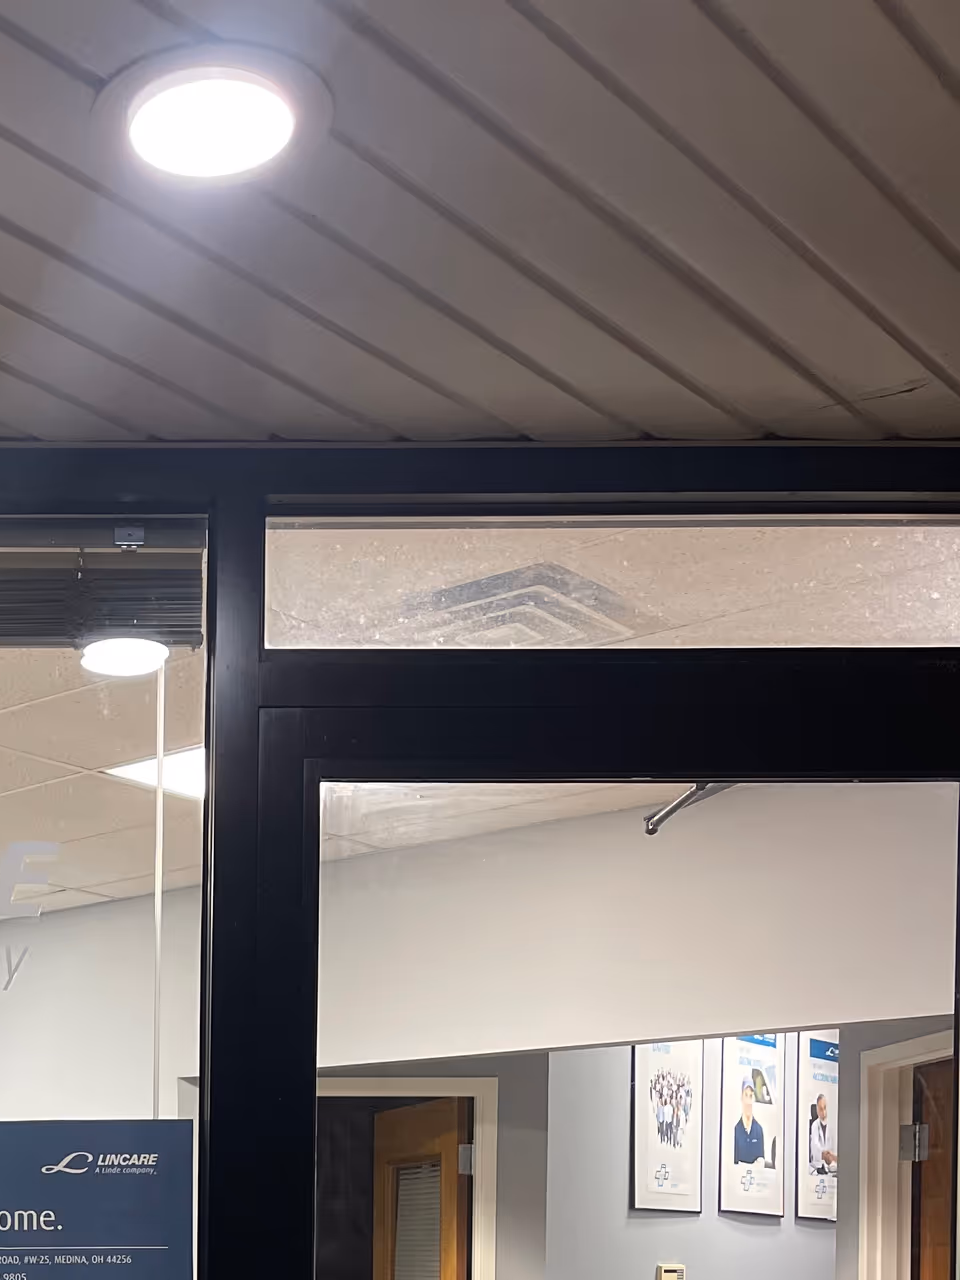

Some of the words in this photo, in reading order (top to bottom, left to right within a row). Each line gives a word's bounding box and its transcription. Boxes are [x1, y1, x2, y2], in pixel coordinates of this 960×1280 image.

[97, 1153, 159, 1166] LINCARE
[102, 1166, 122, 1174] Linde
[54, 1255, 89, 1266] MEDINA,
[92, 1255, 104, 1264] OH
[106, 1255, 132, 1264] 44256
